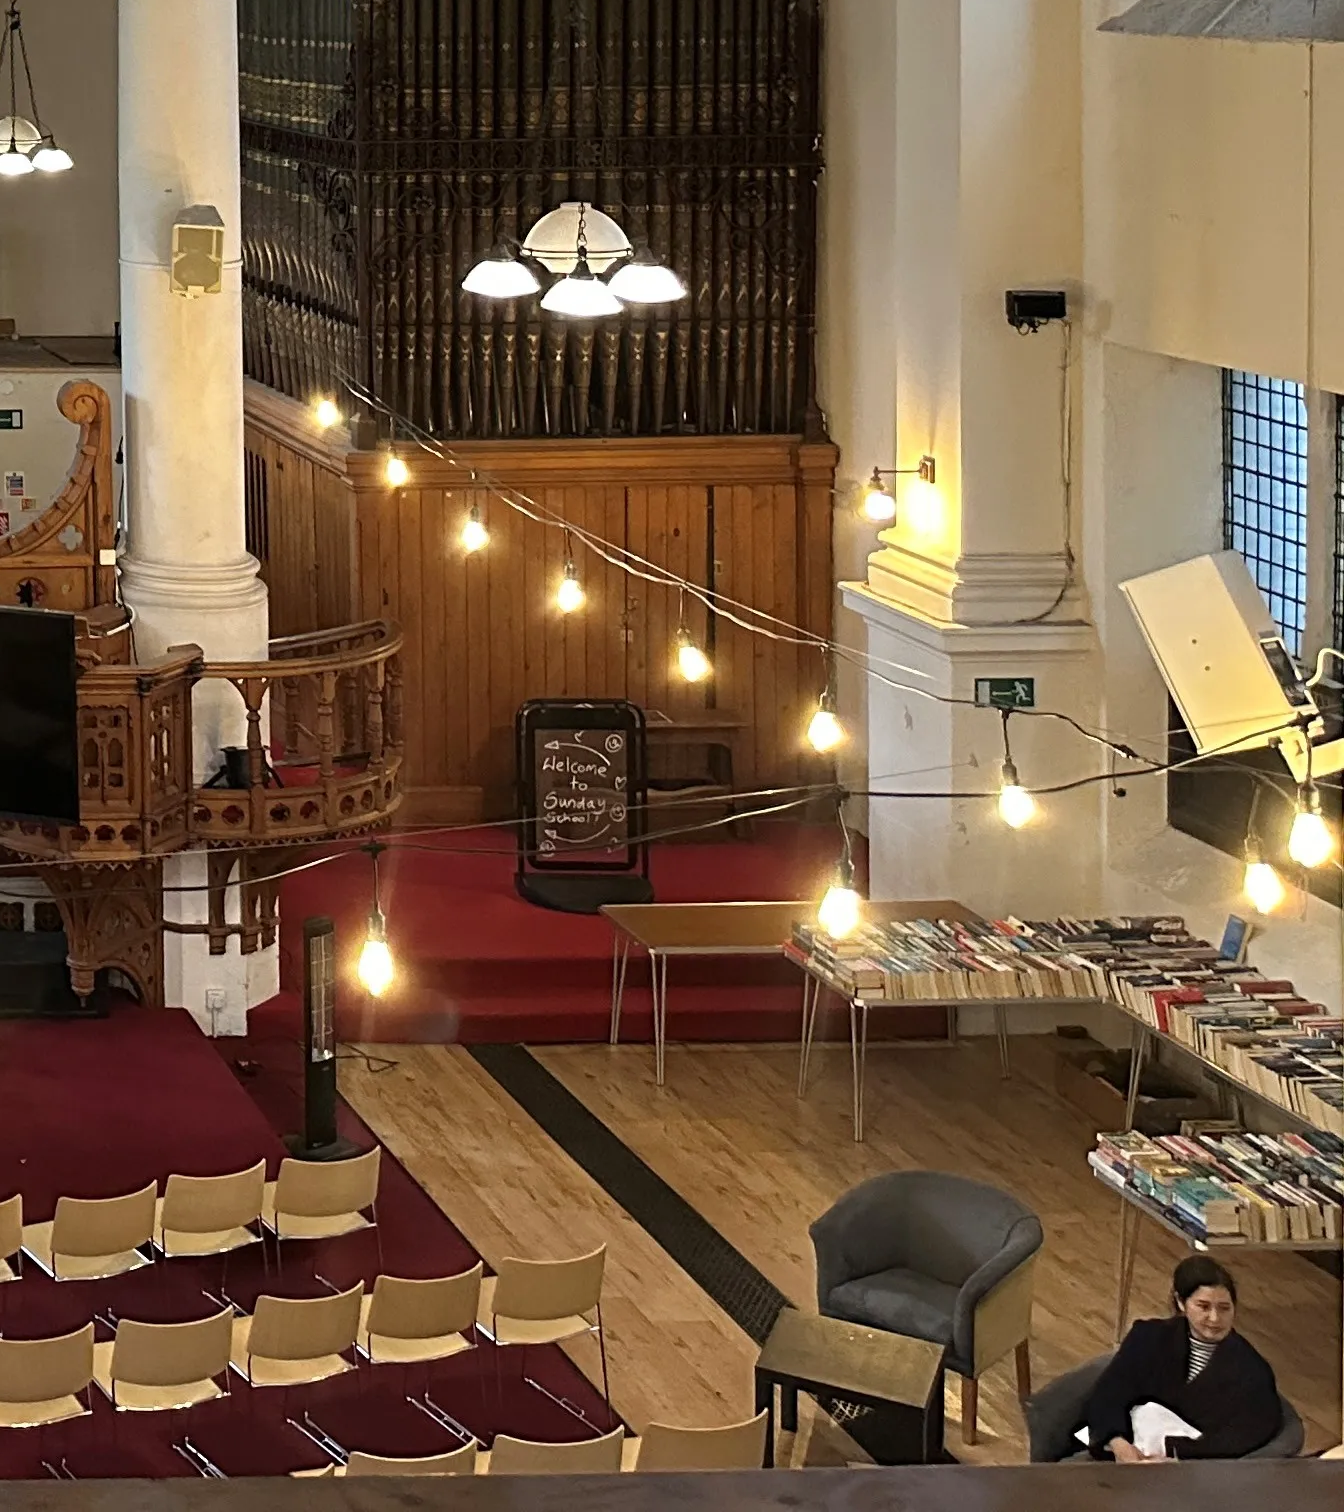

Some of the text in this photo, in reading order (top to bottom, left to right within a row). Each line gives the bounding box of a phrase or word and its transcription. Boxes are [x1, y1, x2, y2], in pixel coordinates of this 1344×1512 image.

[542, 754, 608, 778] Welcome
[569, 775, 589, 791] to
[543, 791, 607, 815] Sunday
